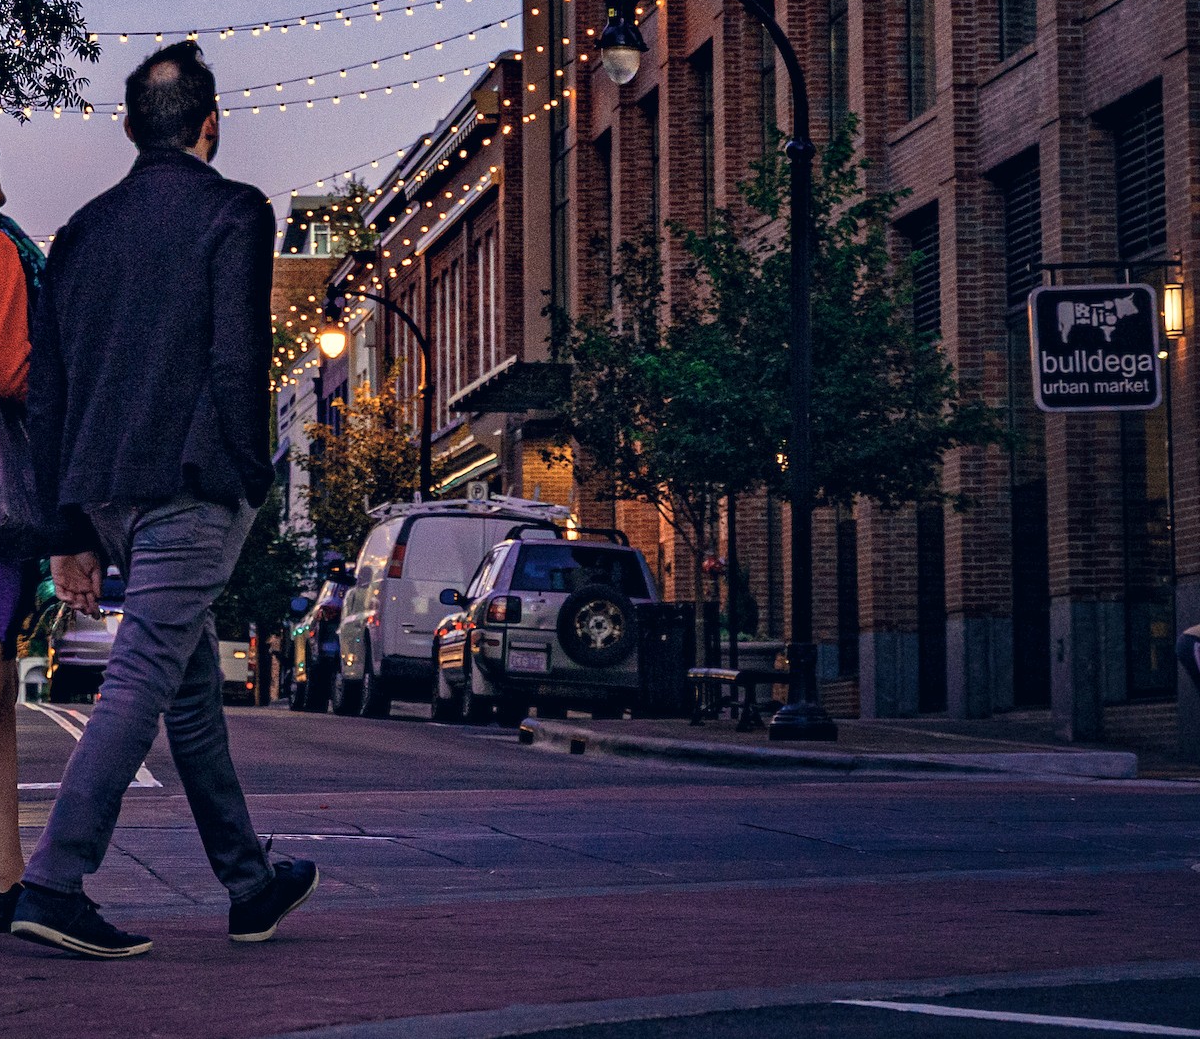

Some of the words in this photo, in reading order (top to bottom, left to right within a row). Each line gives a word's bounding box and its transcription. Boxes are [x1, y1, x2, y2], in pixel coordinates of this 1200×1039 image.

[1041, 349, 1154, 378] bulldega
[1043, 379, 1090, 395] urban
[1094, 378, 1150, 394] market
